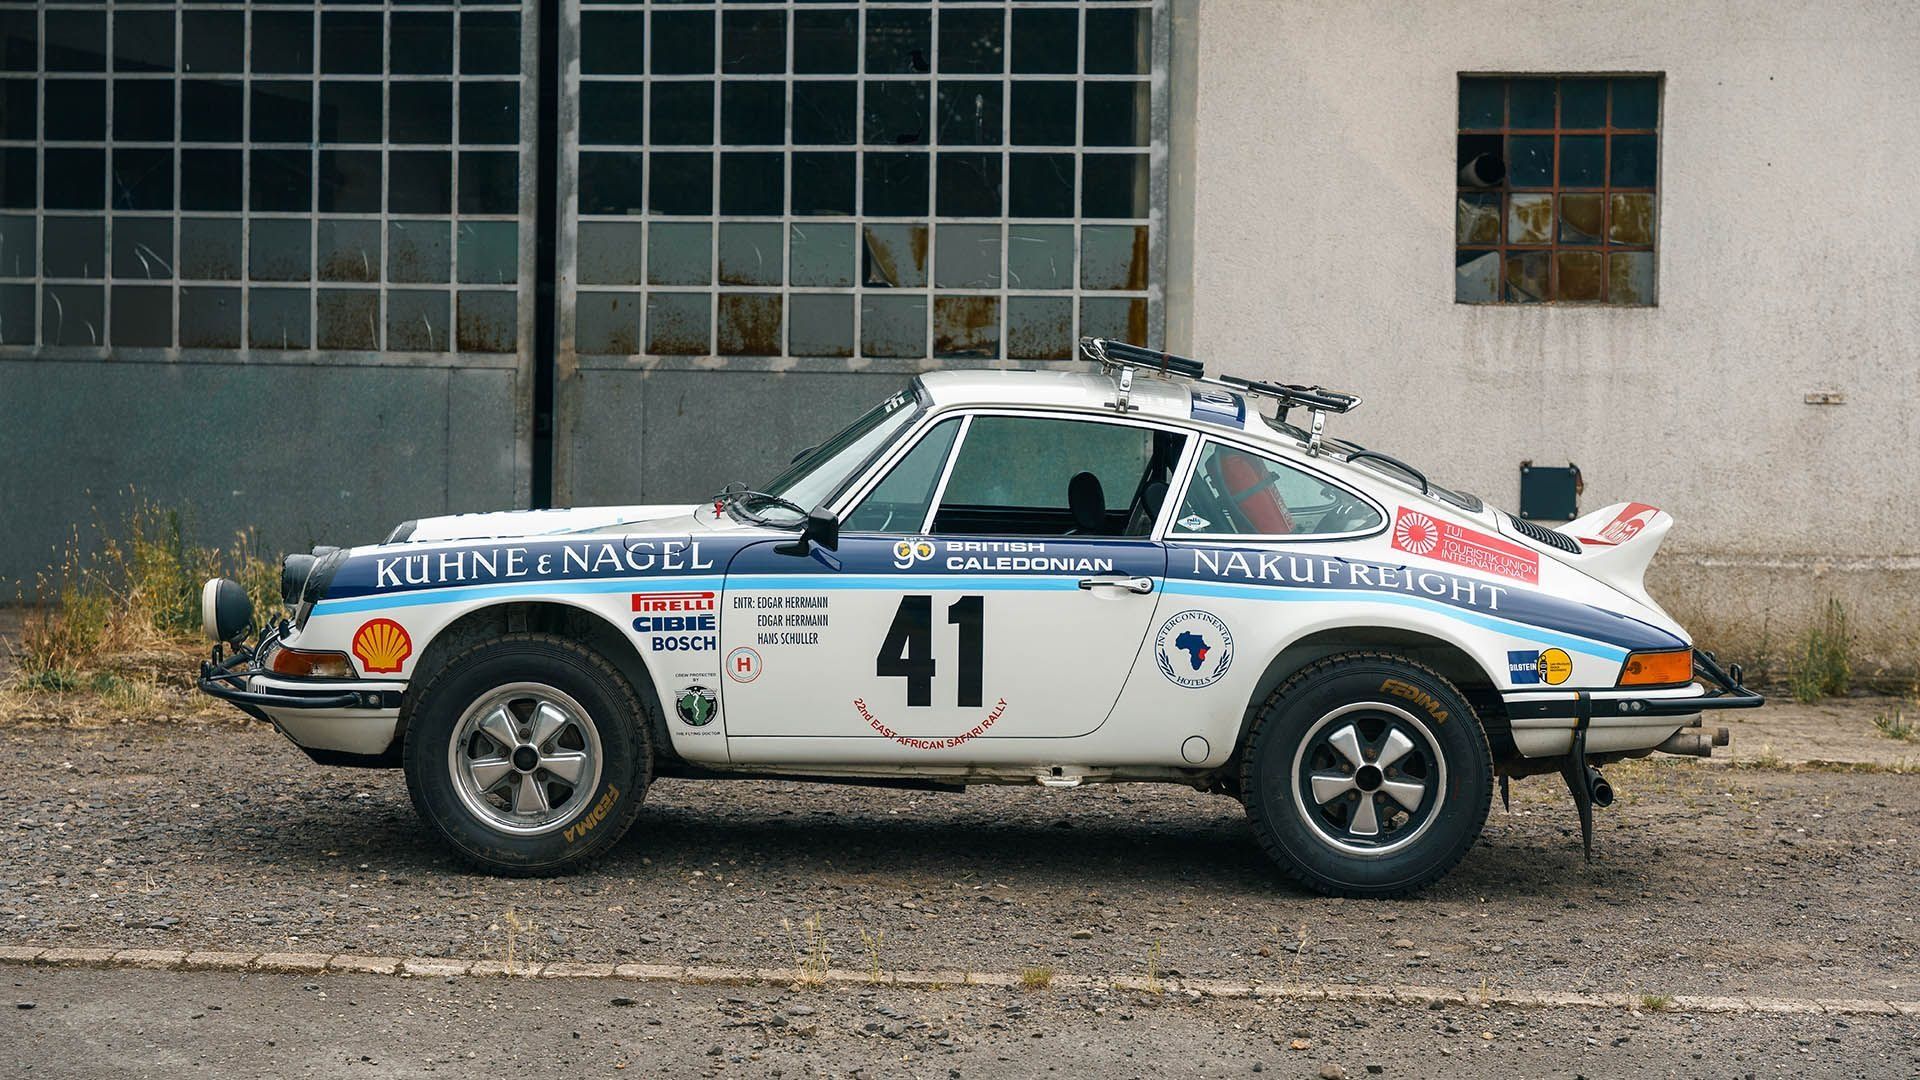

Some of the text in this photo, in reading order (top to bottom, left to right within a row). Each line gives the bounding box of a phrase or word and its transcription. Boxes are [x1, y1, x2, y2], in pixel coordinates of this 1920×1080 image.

[1446, 525, 1463, 537] TUI
[893, 540, 936, 569] go
[946, 541, 1045, 552] BRITISH
[1444, 540, 1537, 575] TOURISTIK UNION
[376, 547, 528, 588] KÜHNE
[562, 541, 714, 575] NAGEL
[946, 557, 1113, 571] CALEDONIAN
[1441, 551, 1526, 578] INTERNATIONAL
[1193, 550, 1508, 611] NAKUFREIGHT
[632, 592, 714, 612] PIRELLI
[734, 596, 828, 609] ENTR: EDGAR HERRMANN
[757, 614, 829, 627] EDGAR HERRMANN
[1157, 612, 1231, 648] INTERCONTINENTAL
[652, 636, 716, 651] BOSCH
[757, 632, 818, 645] HANS SCHULLER
[876, 595, 984, 707] 41
[737, 658, 751, 672] H
[1176, 676, 1211, 686] HOTELS
[1380, 679, 1448, 724] FEDIMA
[854, 697, 1008, 750] 22nd EAST AFRICAN SAFARI RALLY
[563, 783, 619, 843] FEDIMA
